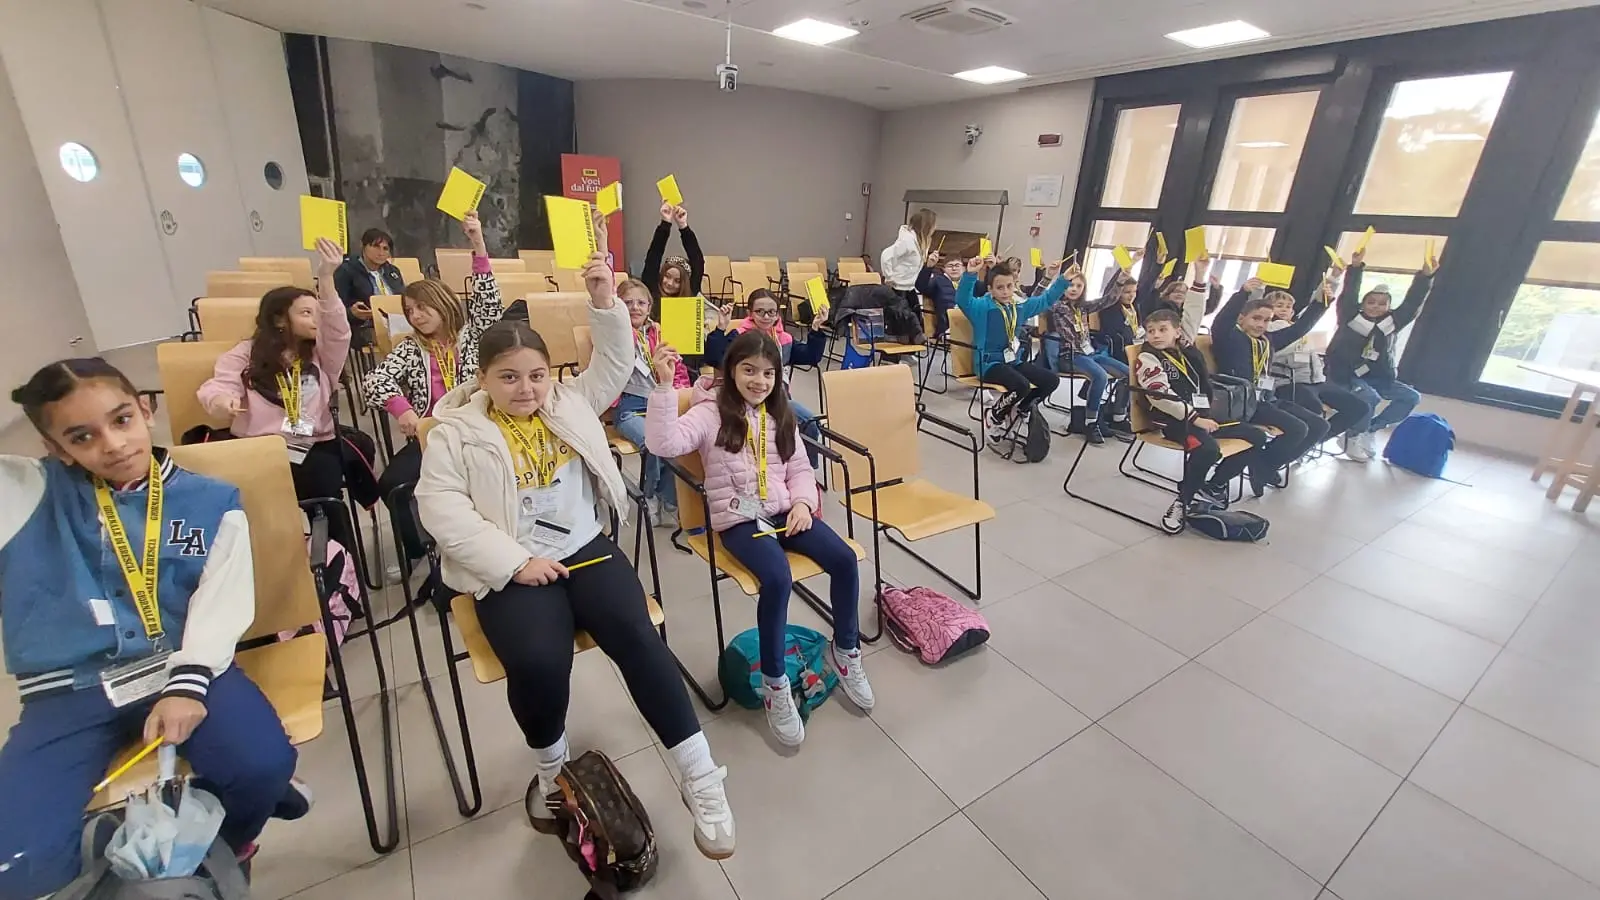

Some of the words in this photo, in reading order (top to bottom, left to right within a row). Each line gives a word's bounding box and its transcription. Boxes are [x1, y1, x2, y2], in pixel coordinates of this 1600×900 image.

[570, 184, 584, 192] dal
[581, 176, 600, 185] Voci
[150, 489, 159, 520] GIORNALE
[103, 505, 122, 536] GIORNALE
[115, 536, 125, 546] DI
[146, 538, 156, 566] BRESCIA
[168, 518, 207, 556] LA
[117, 544, 136, 574] BRESCIA
[136, 590, 155, 622] GIORNALE
[147, 621, 159, 632] DI
